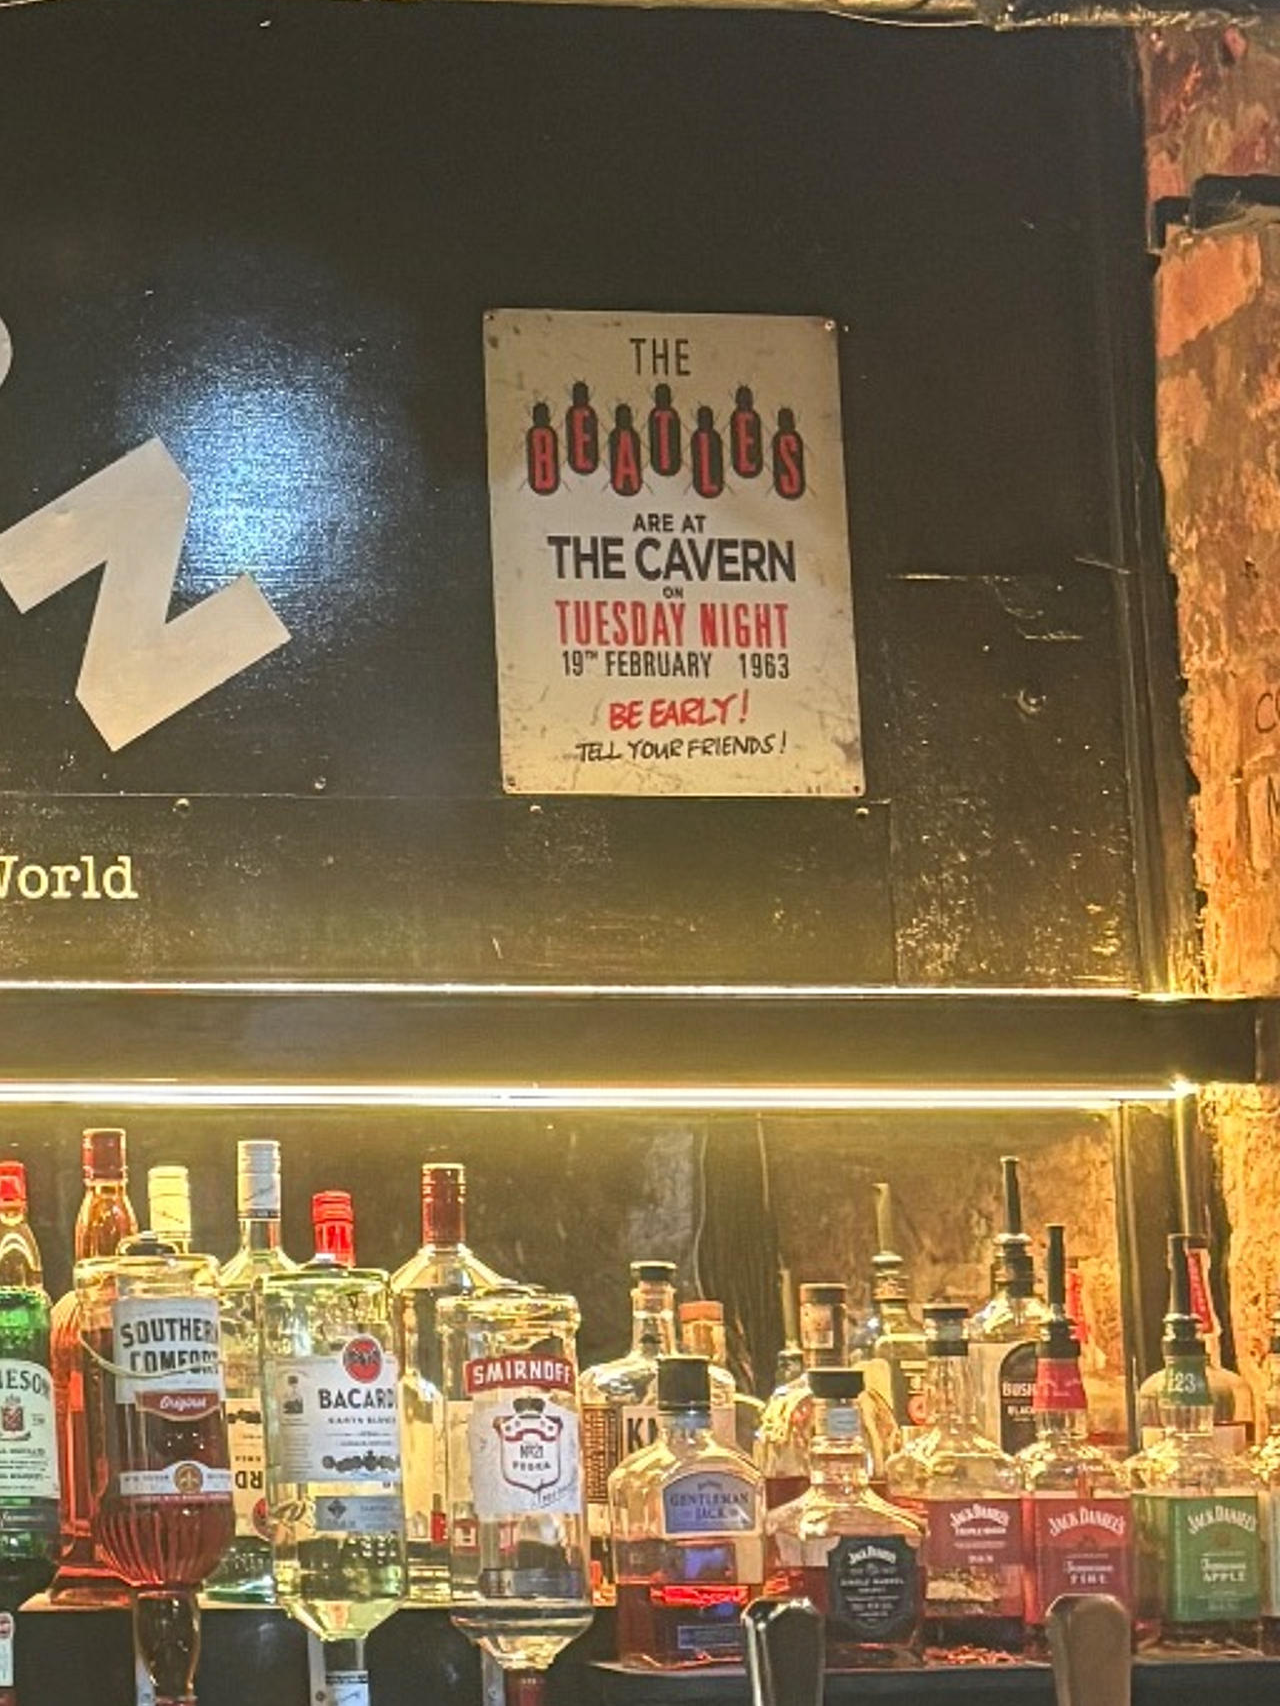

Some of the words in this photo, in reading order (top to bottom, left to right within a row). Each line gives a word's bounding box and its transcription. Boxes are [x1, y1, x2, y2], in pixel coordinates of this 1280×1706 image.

[630, 338, 691, 376] THE
[533, 408, 799, 494] BEATLES
[633, 513, 673, 533] ARE
[681, 514, 706, 534] AT
[547, 536, 626, 580] THE
[634, 538, 797, 582] CAVERN
[663, 587, 683, 599] ON
[555, 601, 685, 647] TUESDAY
[700, 604, 788, 649] NIGHT
[605, 651, 712, 678] FEBRUARY
[739, 653, 790, 679] 1963
[609, 701, 643, 730] BE
[650, 689, 750, 729] EARLY!
[575, 741, 620, 763] TELL
[628, 739, 683, 760] YOUR
[473, 1360, 571, 1385] SMIRNOFF
